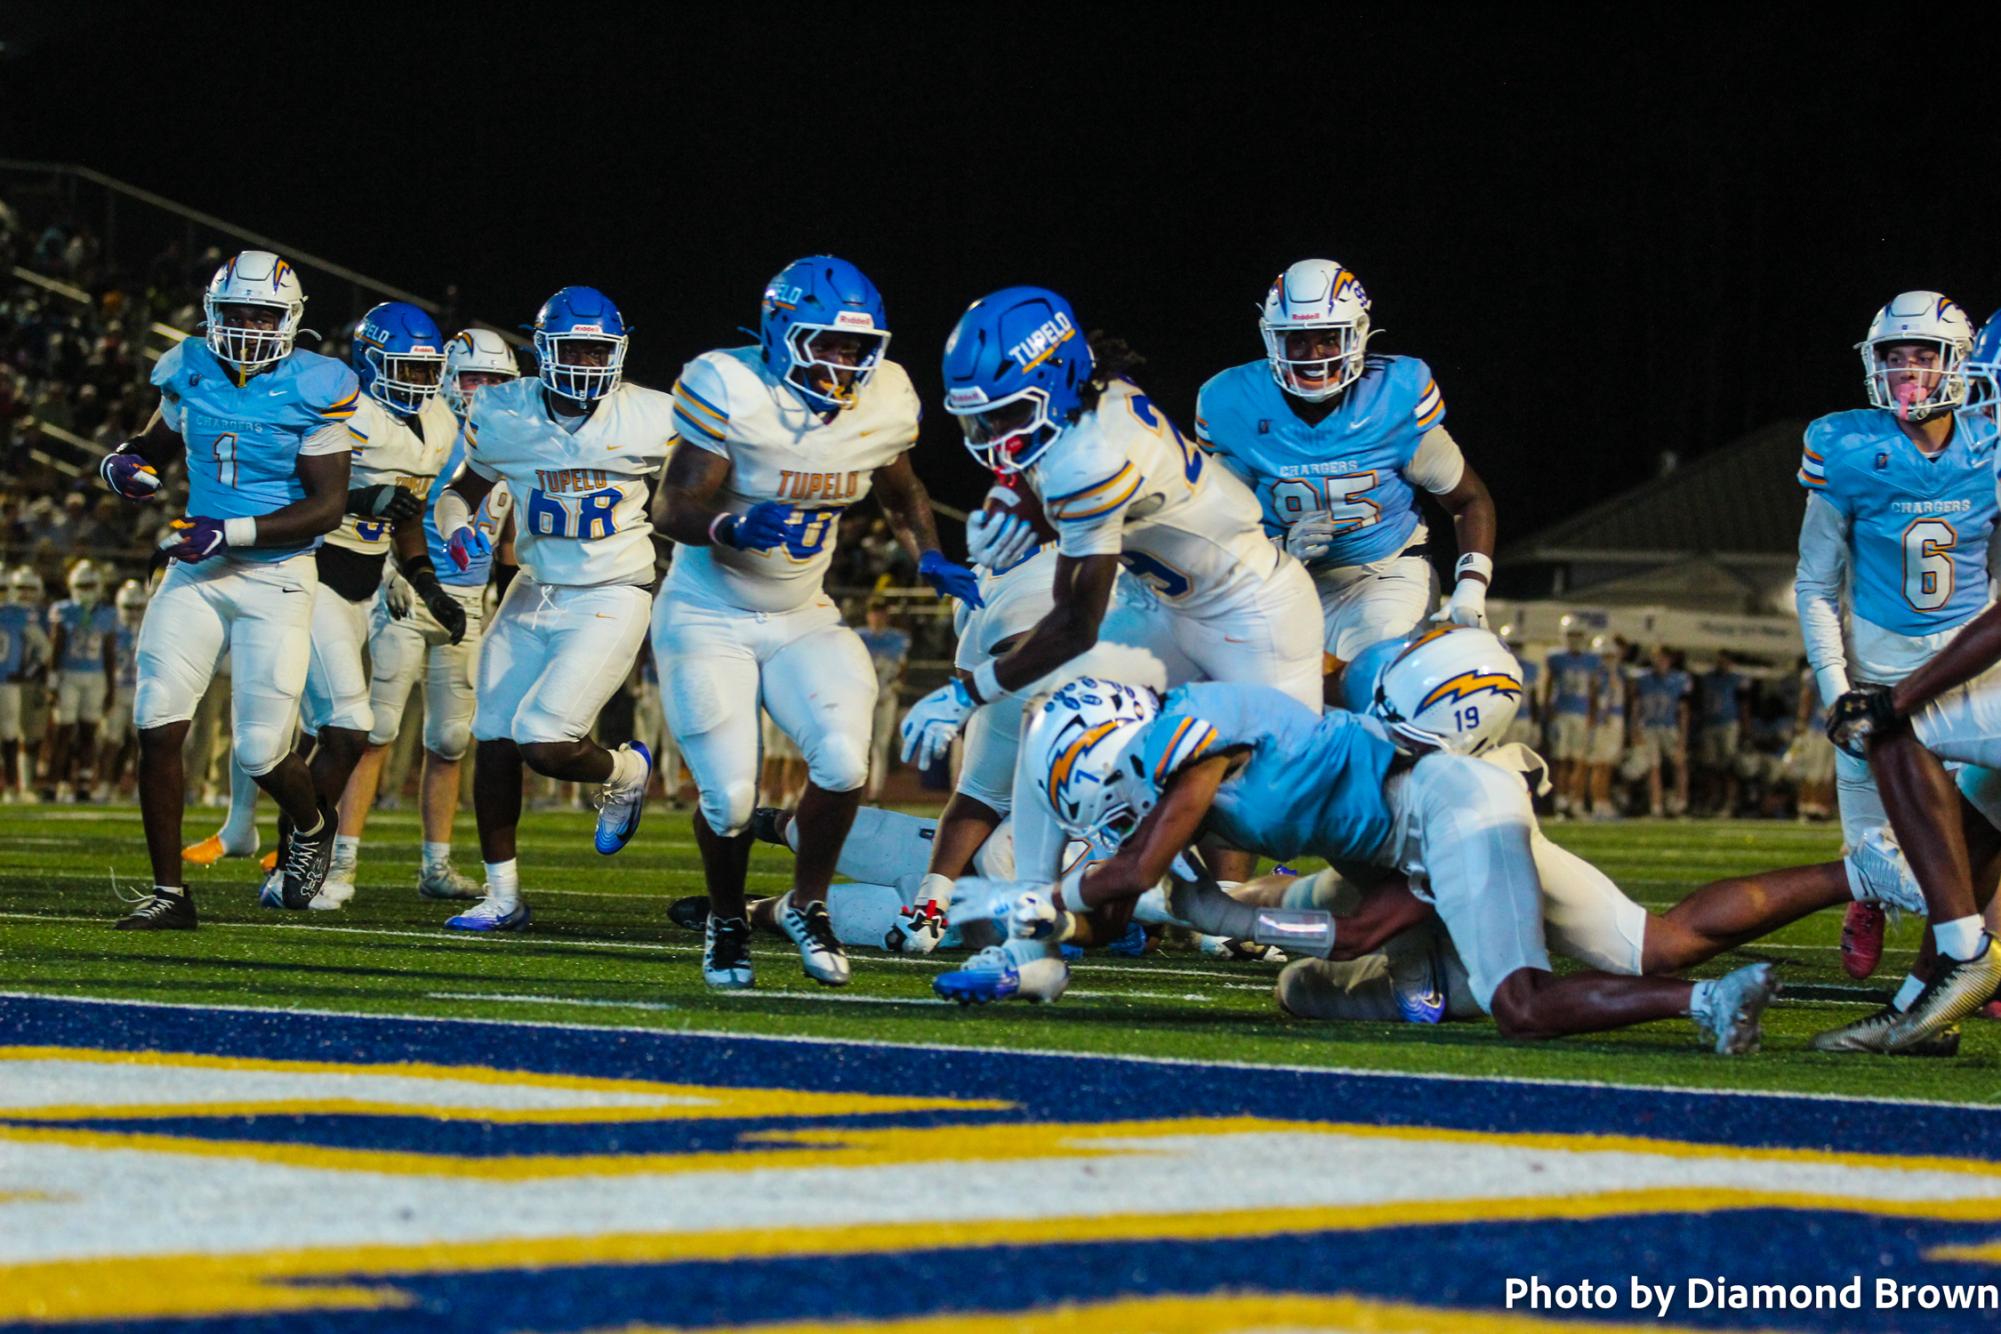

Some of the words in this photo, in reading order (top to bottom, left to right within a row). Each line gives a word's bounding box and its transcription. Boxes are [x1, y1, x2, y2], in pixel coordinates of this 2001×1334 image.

[1008, 311, 1073, 367] TUPELO
[211, 431, 239, 490] 1
[1279, 460, 1359, 477] CHARGERS
[534, 469, 608, 493] TUPELO
[777, 470, 860, 500] TUPELO
[524, 485, 627, 540] 68
[1269, 470, 1382, 529] 95
[1891, 499, 1972, 514] CHARGERS
[1901, 517, 1958, 614] 6
[1453, 705, 1481, 733] 19
[1073, 768, 1101, 785] 7
